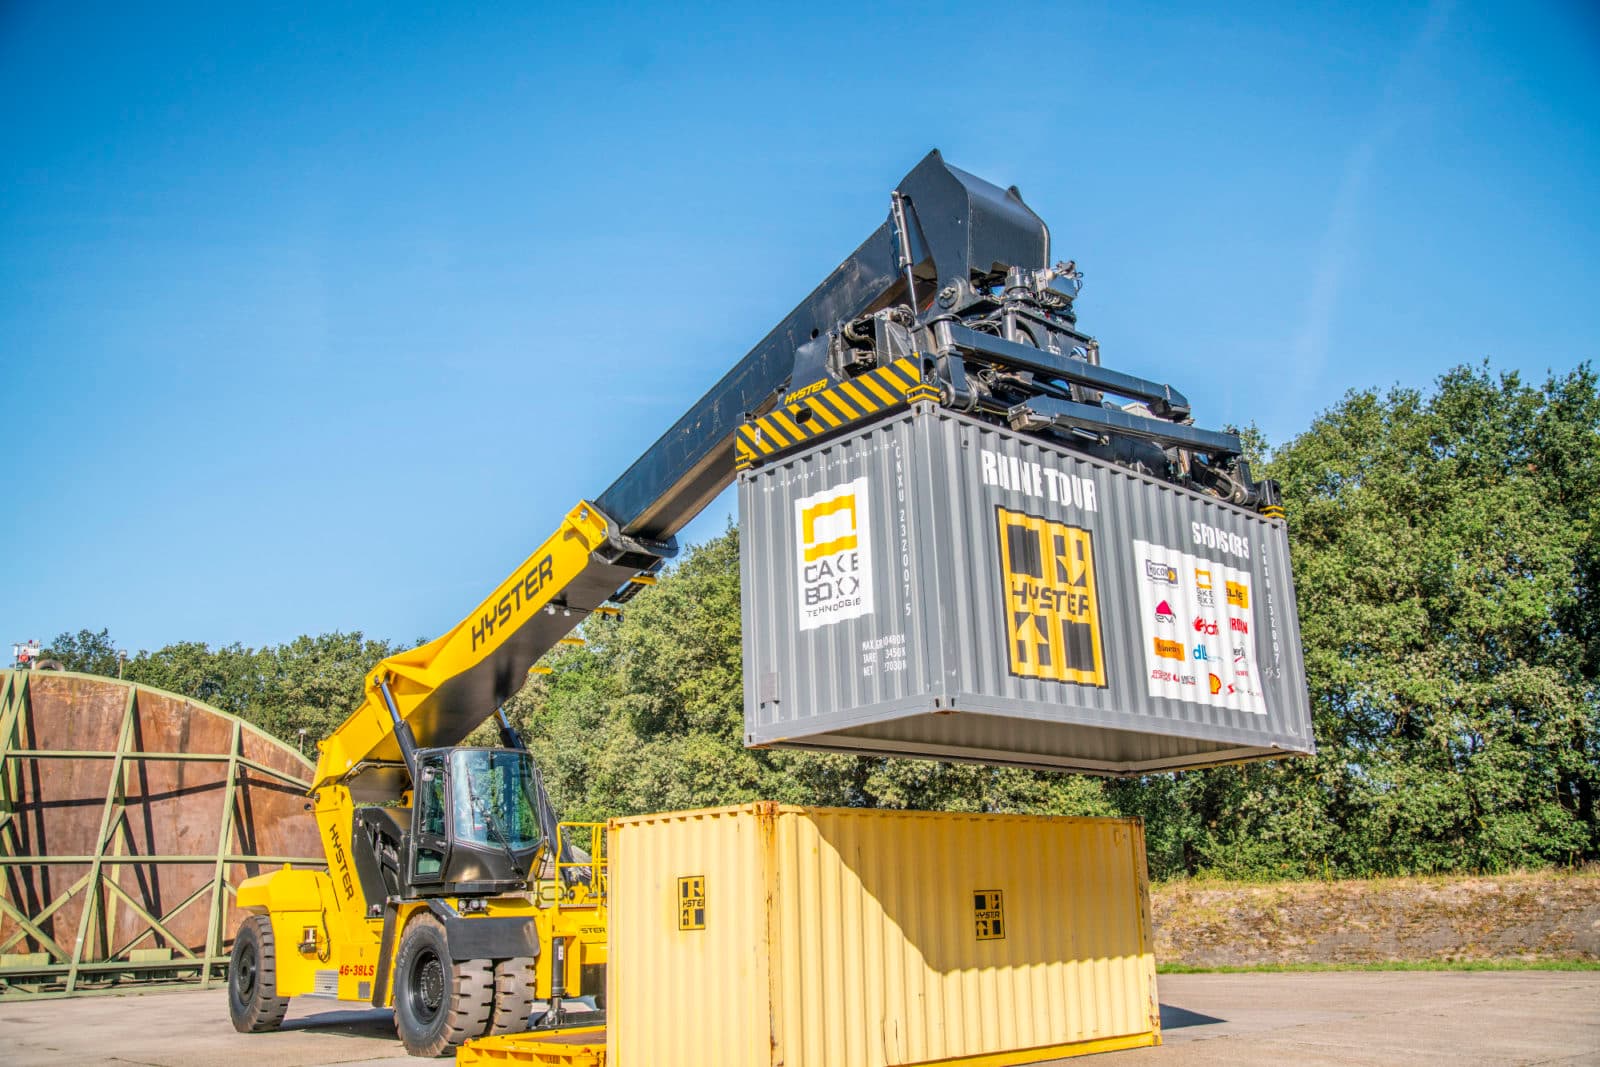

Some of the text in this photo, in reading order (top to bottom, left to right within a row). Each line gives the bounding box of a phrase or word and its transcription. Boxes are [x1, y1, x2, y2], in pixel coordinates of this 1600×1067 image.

[784, 378, 829, 405] HYSTER
[980, 449, 1098, 513] RHINE TOUR
[471, 553, 554, 652] HYSTER
[1012, 581, 1090, 617] HYSTER
[329, 823, 355, 901] HYSTER
[339, 965, 374, 977] 46-38LS
